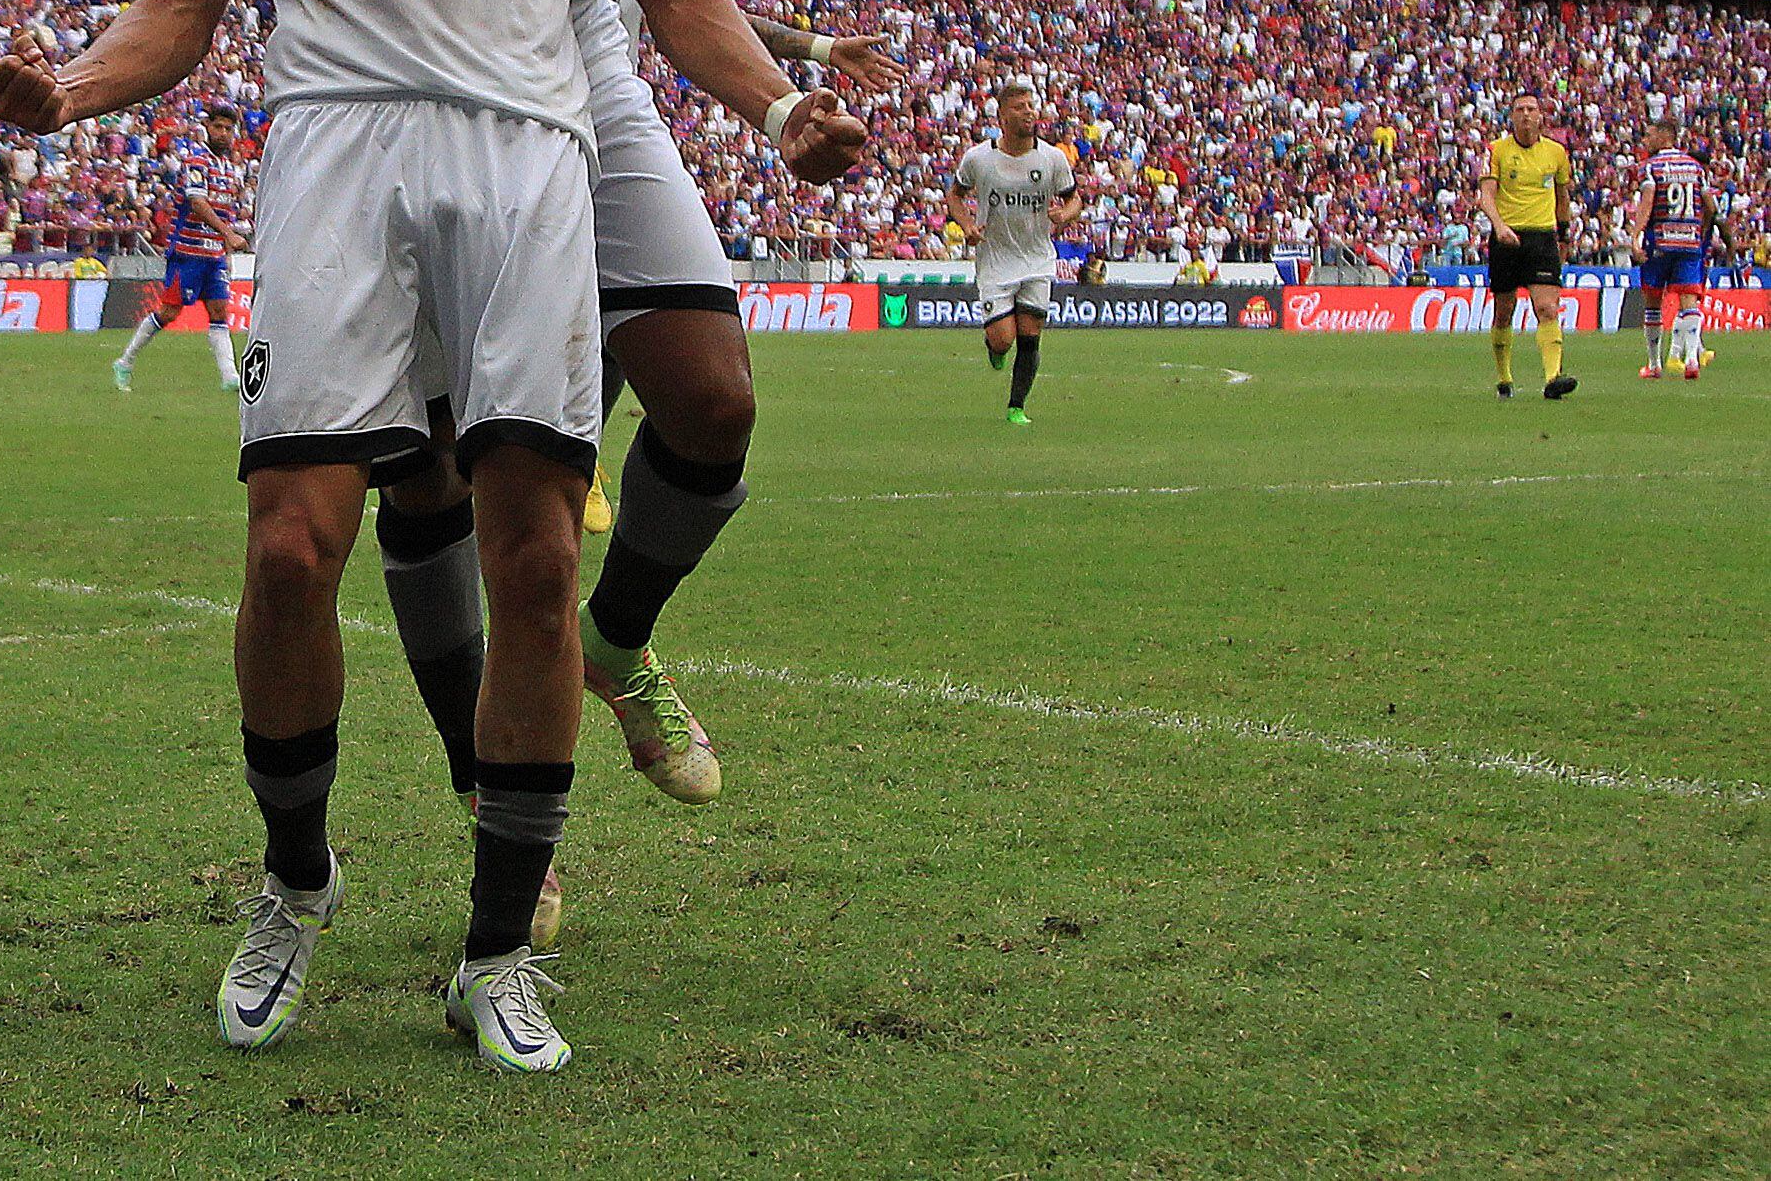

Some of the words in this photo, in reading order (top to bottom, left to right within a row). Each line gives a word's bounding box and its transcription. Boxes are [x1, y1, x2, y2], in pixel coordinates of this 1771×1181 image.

[1666, 183, 1696, 219] 91
[1164, 300, 1228, 324] 2022
[1288, 291, 1395, 331] Cerveja
[1696, 294, 1765, 330] ERVEJA
